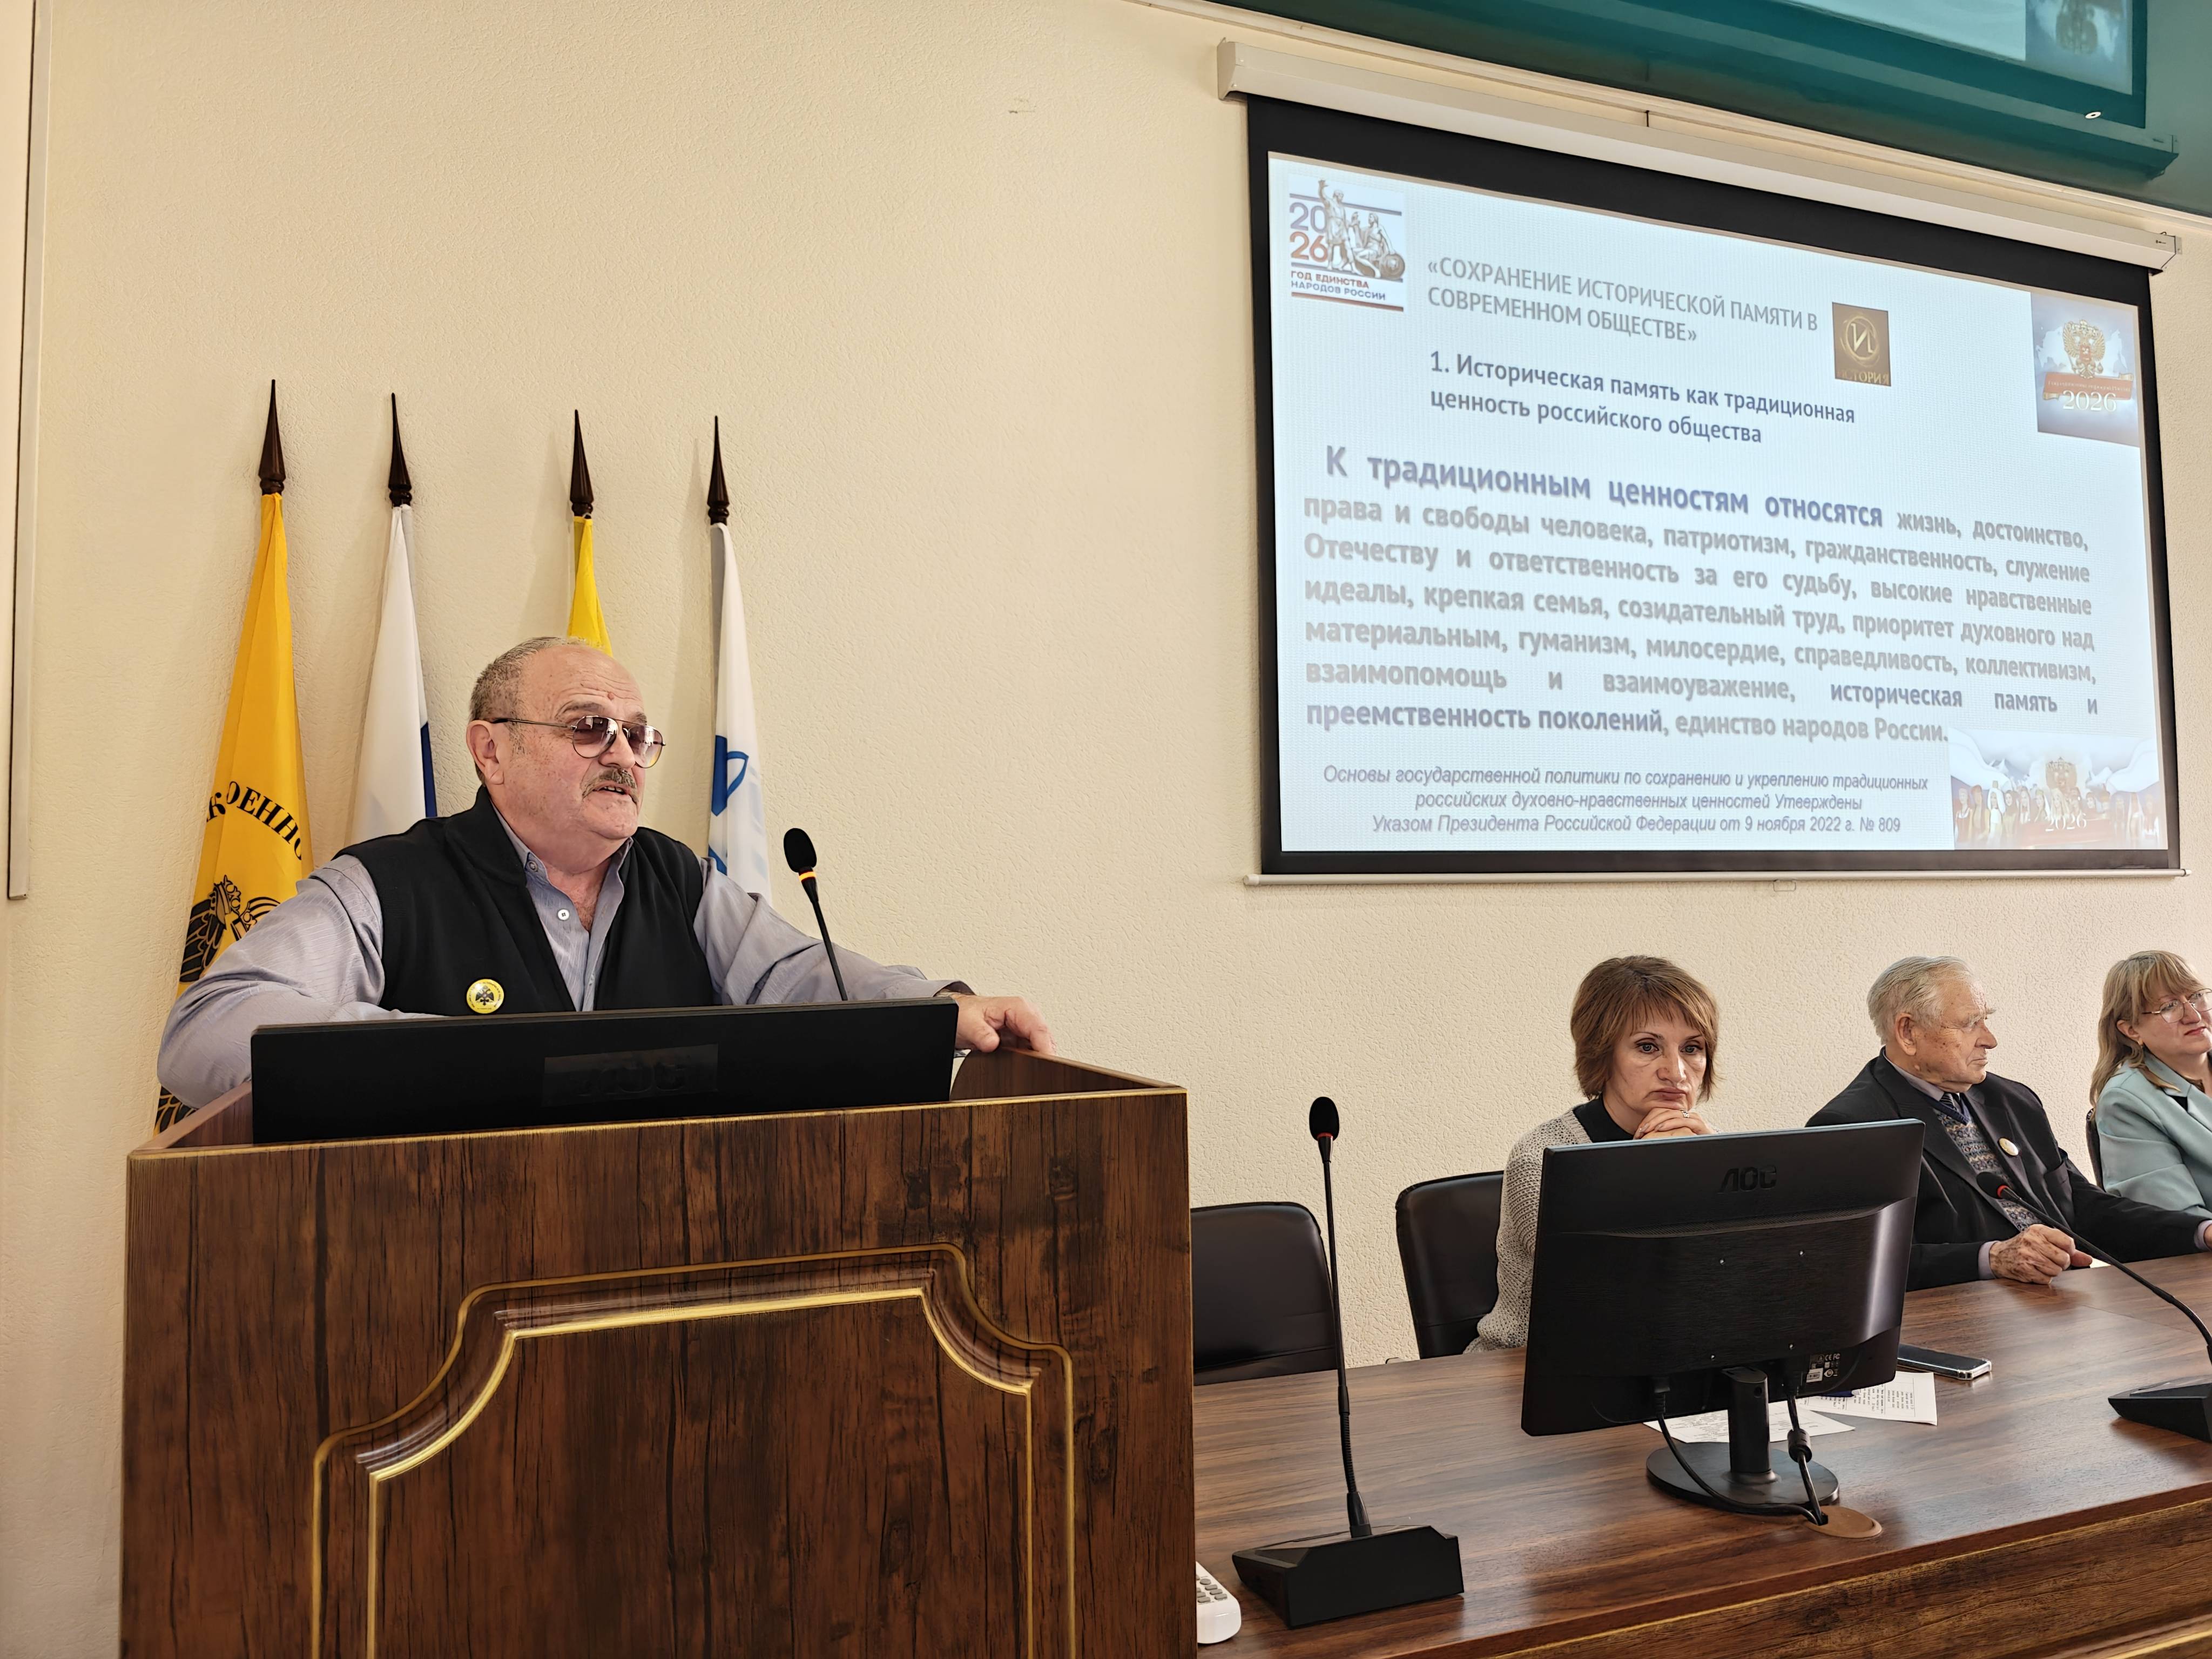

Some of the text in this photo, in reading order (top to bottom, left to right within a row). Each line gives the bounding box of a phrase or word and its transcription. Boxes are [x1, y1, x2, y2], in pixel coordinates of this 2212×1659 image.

[1290, 202, 1328, 233] 20
[1290, 231, 1329, 262] 26
[1291, 271, 1369, 289] ГОД ЕДИНСТВА
[1291, 281, 1386, 301] НАРОДОВ РОССИИ
[1428, 257, 1818, 331] «СОХРАНЕНИЕ ИСТОРИЧЕСКОЙ ПАМЯТИ В
[1428, 286, 1697, 341] СОВРЕМЕННОМ ОБЩЕСТВЕ»
[1430, 350, 1855, 424] 1. Историческая память как традиционная
[2063, 390, 2117, 412] 2026
[1431, 390, 1762, 443] ценность российского общества
[1326, 445, 2088, 551] К традиционным ценностям относятся жизнь, достоинство,
[1304, 498, 2090, 583] права и свободы человека, патриотизм, гражданственность, служение
[1305, 533, 2092, 616] Отечеству и ответственность за его судьбу, высокие нравственные
[1305, 581, 2095, 652] идеалы, крепкая семья, созидательный труд, приоритет духовного над
[1306, 622, 2096, 685] материальным, гуманизм, милосердие, справедливость, коллективизм,
[1307, 663, 2098, 715] взаимопомощь и взаимоуважение, историческая память и
[1307, 705, 1948, 743] преемственность поколений, единство народов России.
[1324, 765, 1928, 791] Основы государственной политики по сохранению и укреплению традиционных
[1415, 791, 1863, 812] российских духовно-нравственных ценностей Утверждены
[1373, 814, 1901, 835] Указом Президента Российской Федерации от 9 ноября 2022 г. № 809
[2045, 811, 2087, 832] 2026
[1717, 1166, 1777, 1194] AOC
